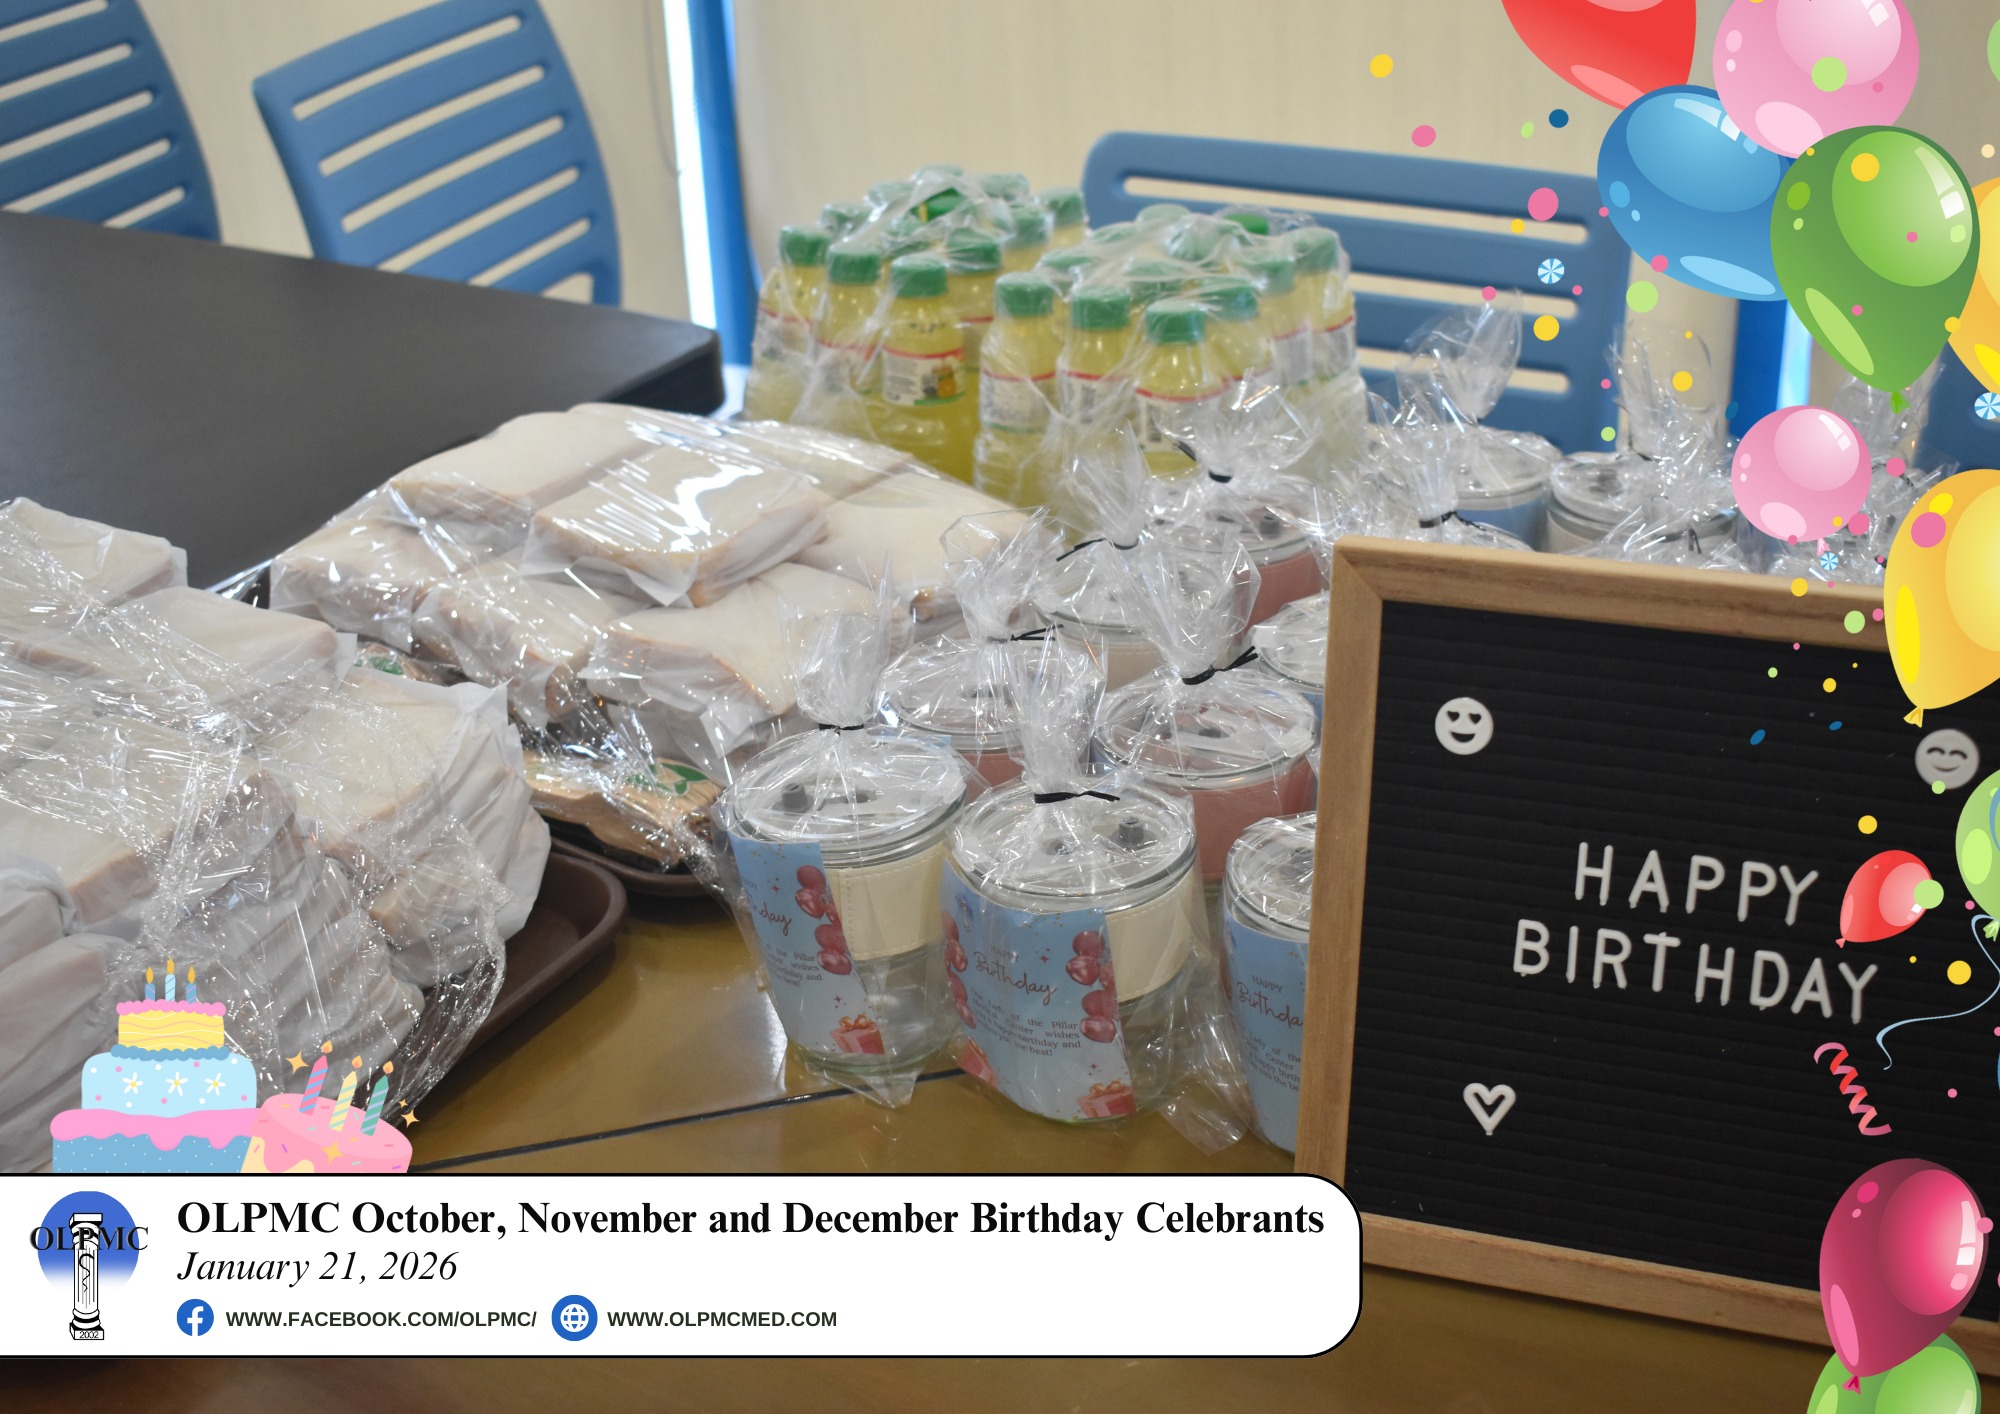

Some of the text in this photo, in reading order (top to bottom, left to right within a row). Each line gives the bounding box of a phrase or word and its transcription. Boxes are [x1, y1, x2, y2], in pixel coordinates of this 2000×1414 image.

[1574, 842, 1819, 926] HAPPY
[793, 952, 816, 962] Pillar
[974, 951, 1058, 1006] Birthday
[1513, 918, 1879, 1025] BIRTHDAY
[1252, 975, 1283, 993] HAPPY
[1237, 981, 1304, 1028] Birthda
[1027, 1018, 1044, 1027] the
[1051, 1020, 1078, 1030] Pillar
[1018, 1033, 1058, 1049] birthday
[1062, 1040, 1081, 1048] and
[1045, 1031, 1080, 1039] wishes
[1029, 1045, 1053, 1056] best!
[1265, 1052, 1294, 1071] Center
[1278, 1067, 1301, 1083] birth
